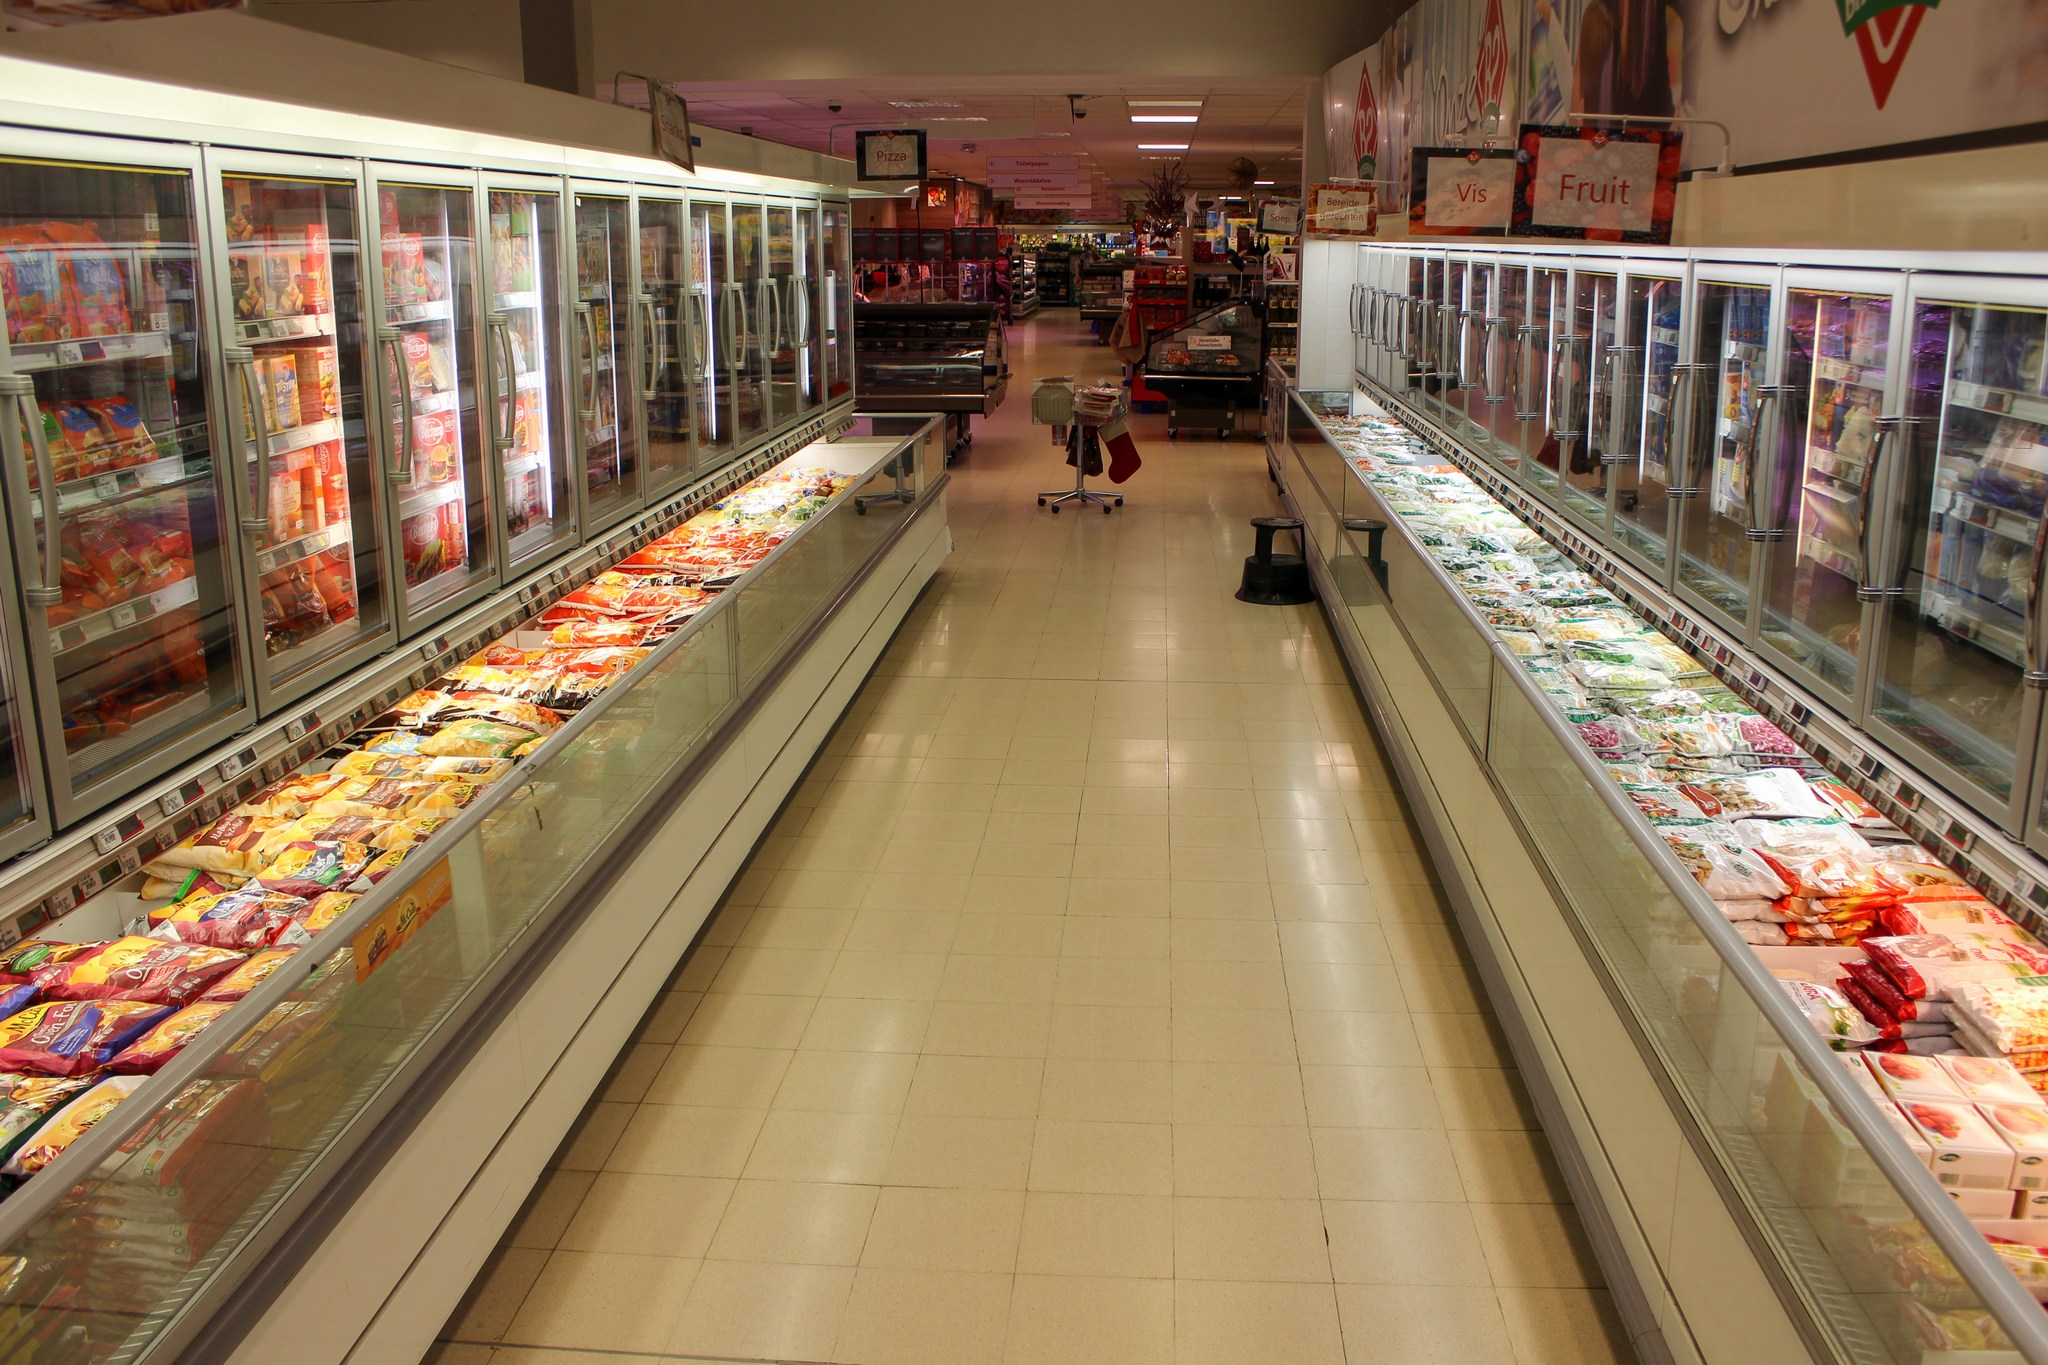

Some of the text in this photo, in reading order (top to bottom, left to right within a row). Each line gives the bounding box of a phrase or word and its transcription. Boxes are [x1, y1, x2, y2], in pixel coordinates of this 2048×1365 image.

[660, 114, 685, 141] Snacks
[876, 150, 907, 163] Pizza
[1015, 160, 1050, 168] Toiletpapier
[1456, 183, 1487, 203] Vis
[1560, 174, 1631, 205] Fruit
[1326, 197, 1360, 207] Bereide
[1270, 213, 1291, 223] Soep
[1319, 209, 1364, 222] gerechten
[420, 423, 444, 442] Beckers
